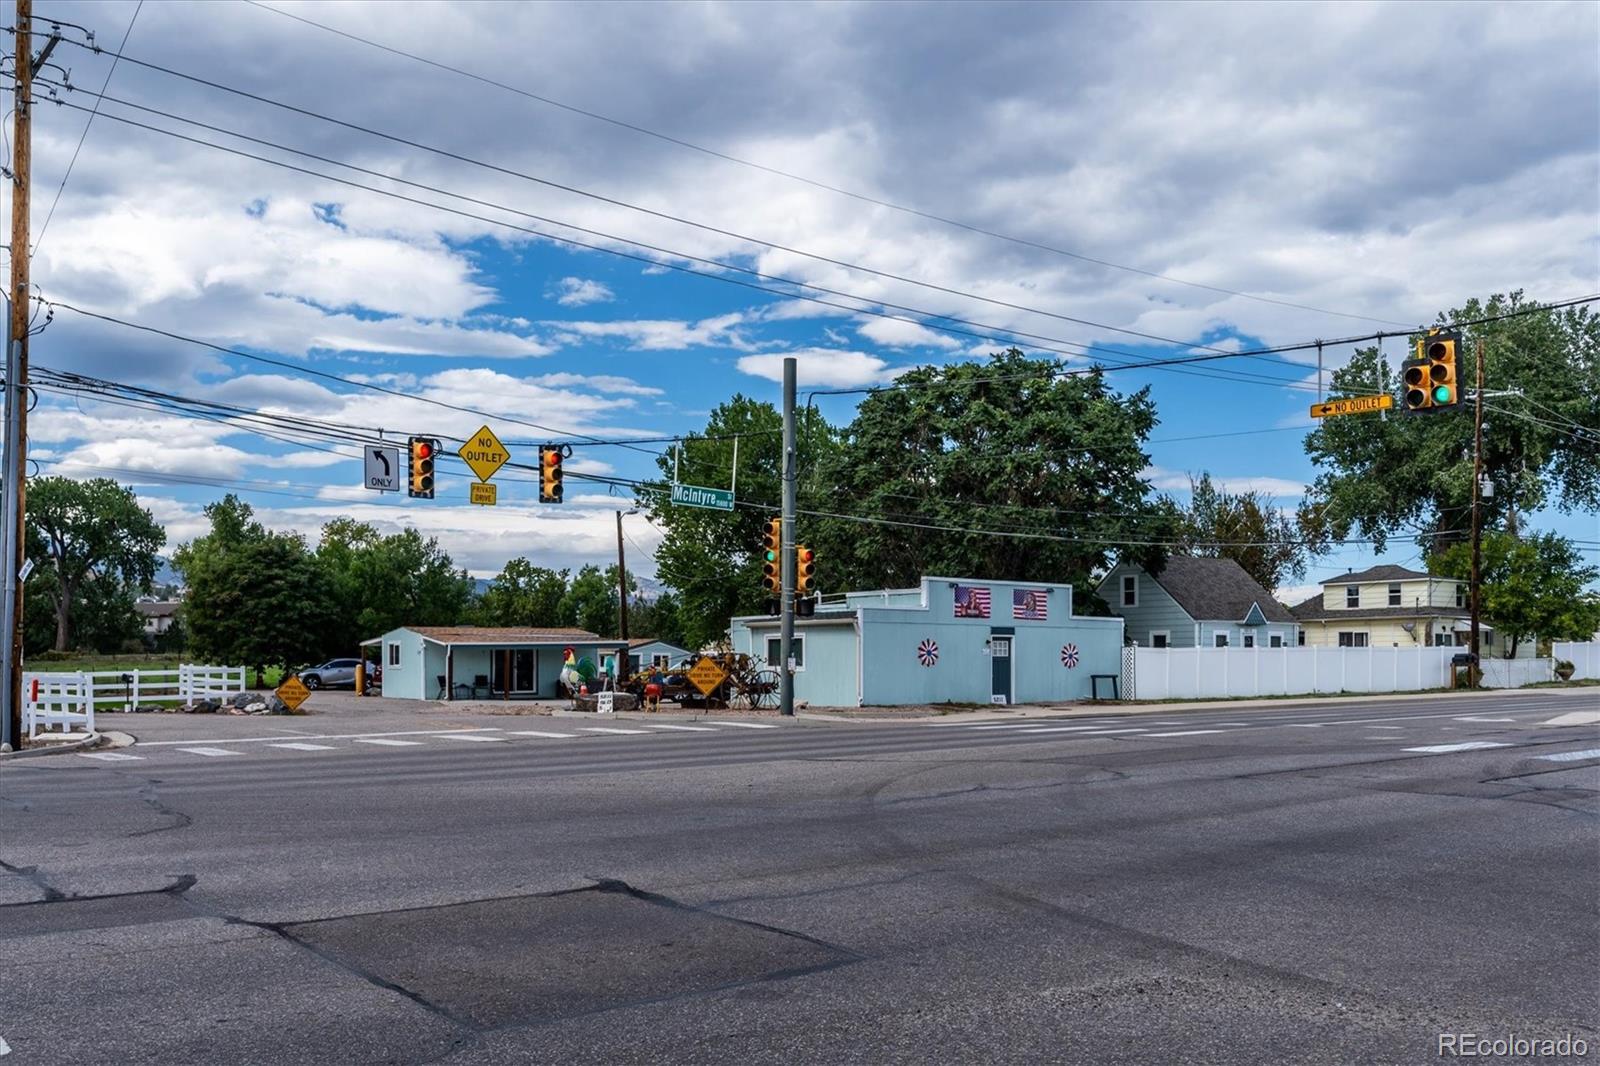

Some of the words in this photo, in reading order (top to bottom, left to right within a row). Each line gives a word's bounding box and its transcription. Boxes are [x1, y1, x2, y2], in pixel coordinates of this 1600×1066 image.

[1335, 403, 1347, 413] NO
[1350, 397, 1381, 410] OUTLET
[478, 438, 492, 448] NO
[466, 451, 503, 463] OUTLET
[371, 477, 393, 487] ONLY
[473, 485, 495, 494] PRIVATE
[474, 494, 492, 503] DRIVE
[673, 486, 716, 505] McIntyre
